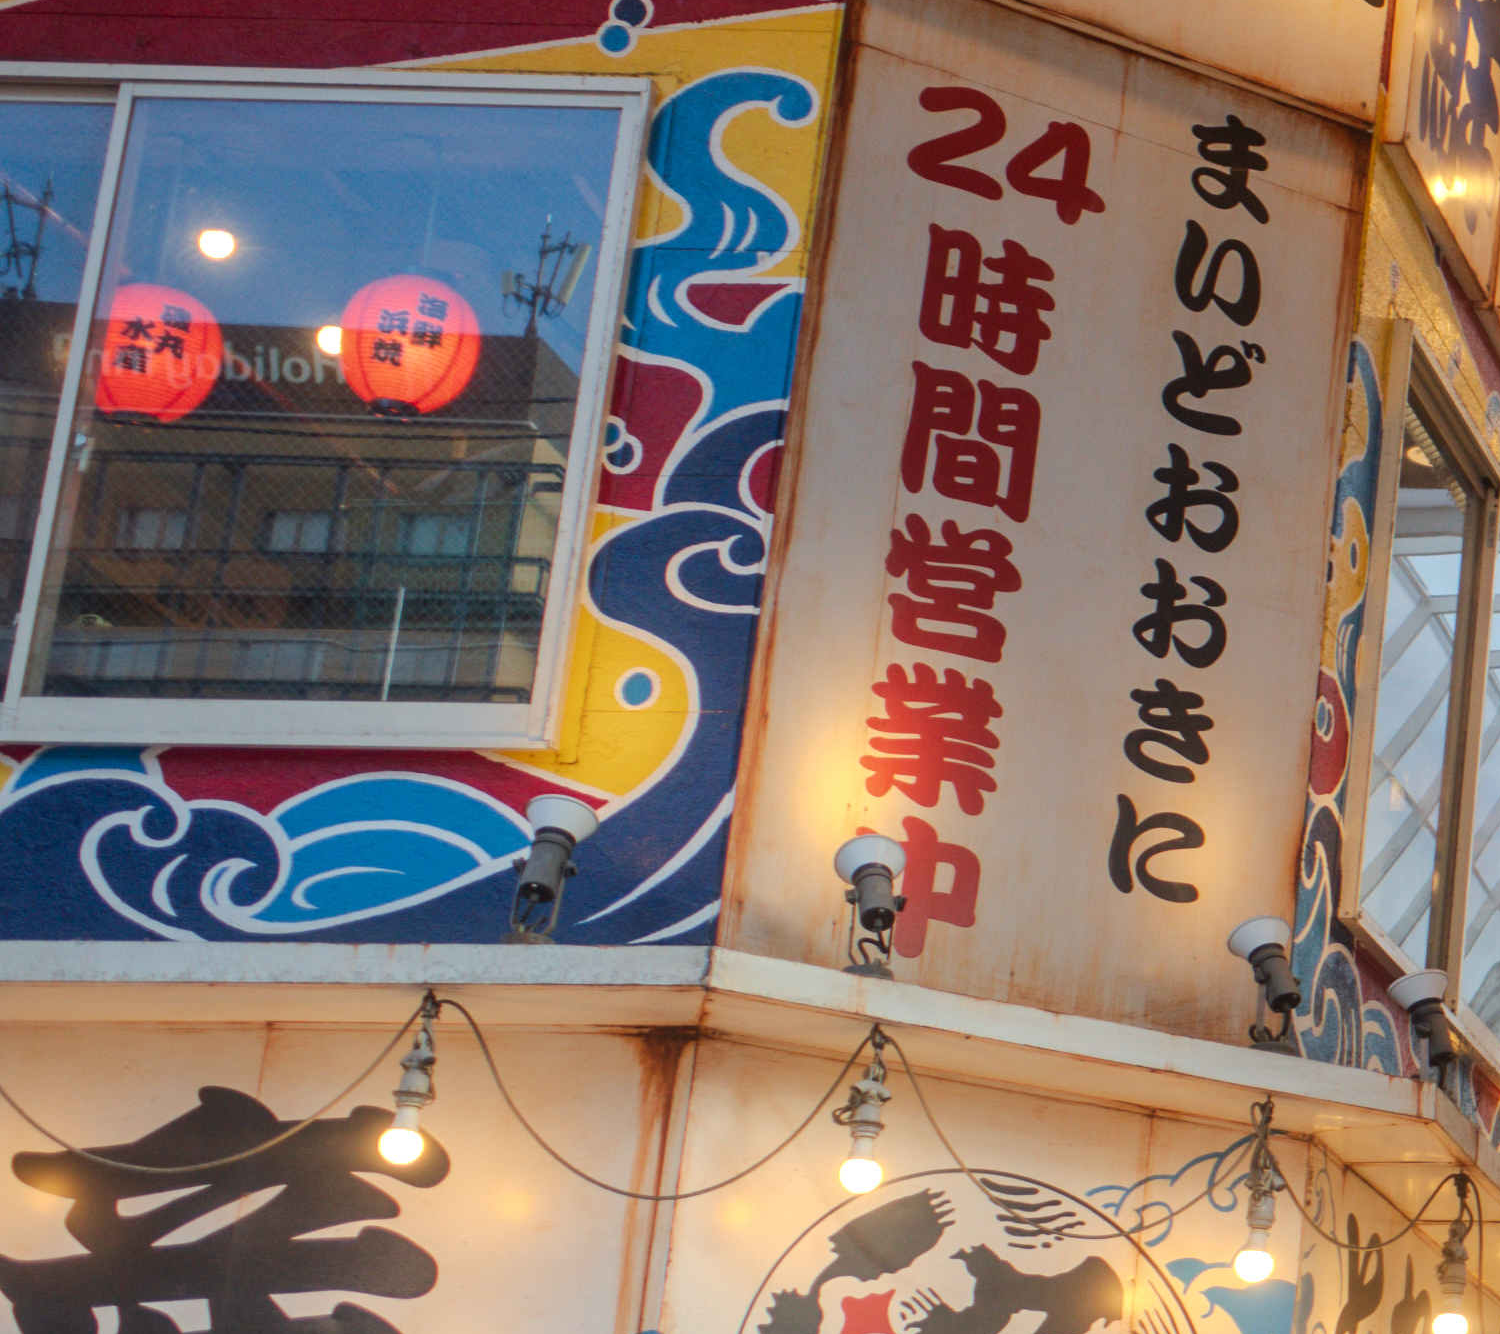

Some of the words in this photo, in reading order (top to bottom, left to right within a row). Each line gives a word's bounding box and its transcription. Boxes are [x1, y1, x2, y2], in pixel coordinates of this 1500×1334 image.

[858, 86, 1106, 959] 24時間営業中
[1110, 114, 1269, 904] まいどおおきに
